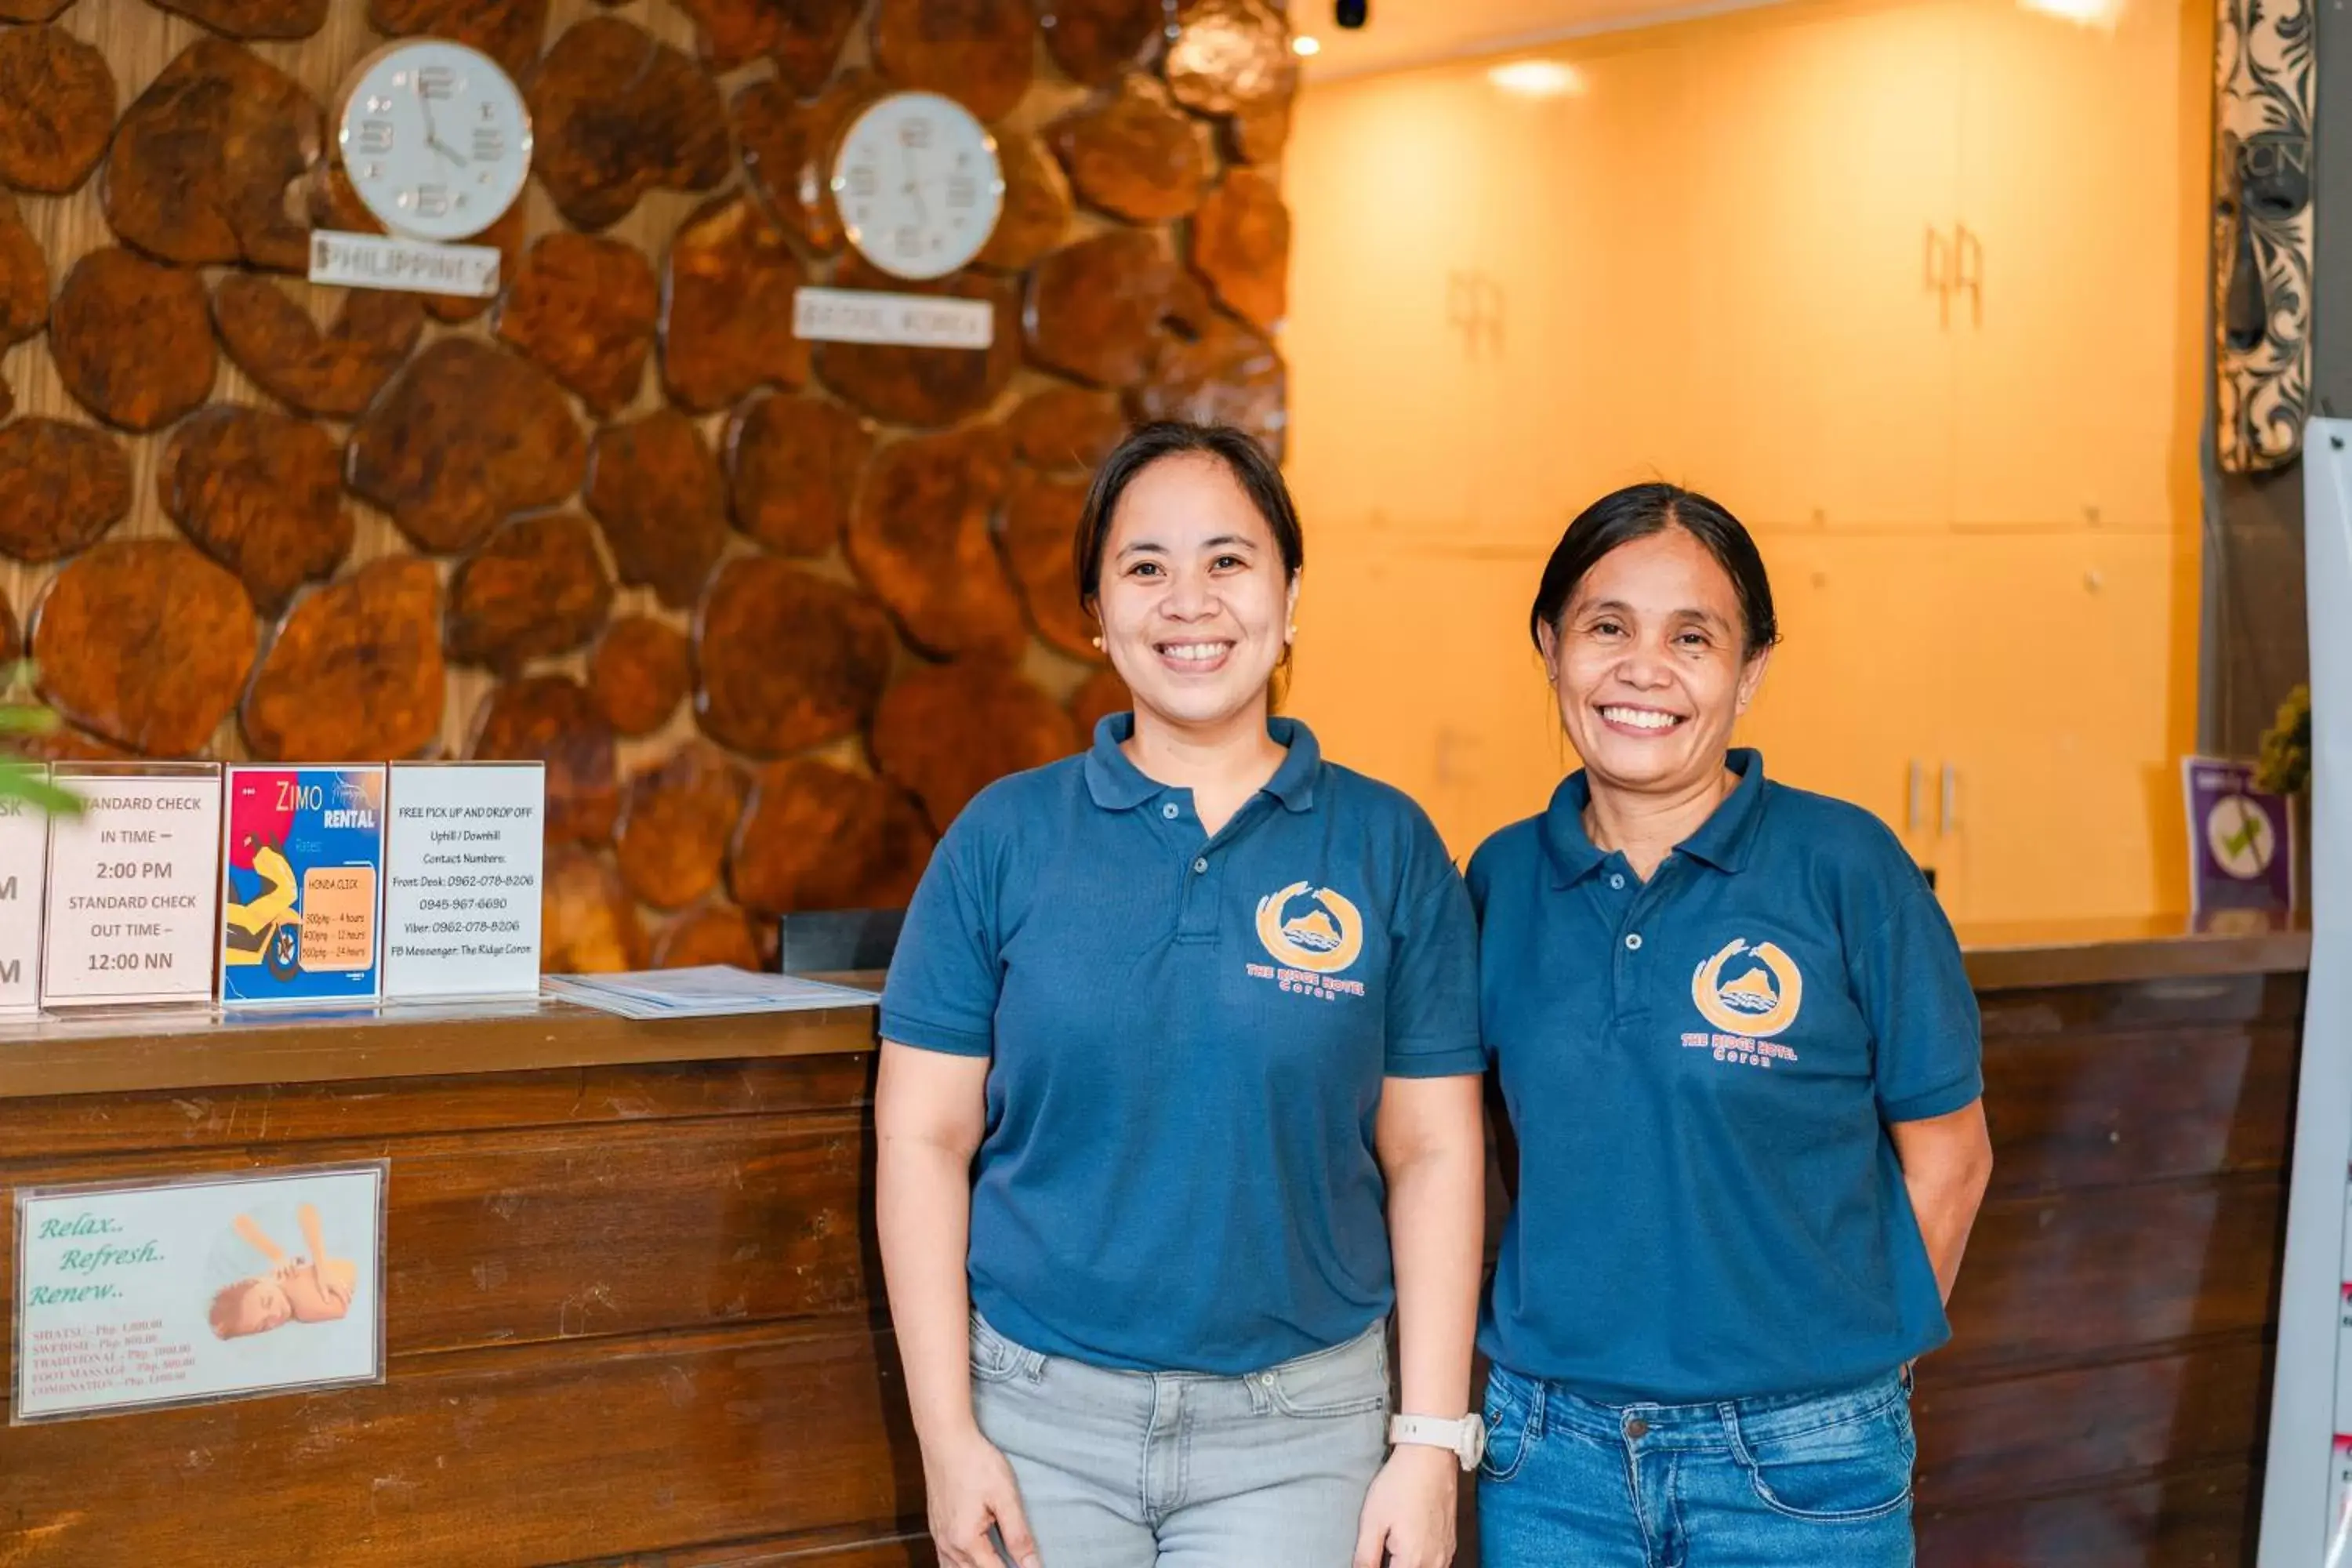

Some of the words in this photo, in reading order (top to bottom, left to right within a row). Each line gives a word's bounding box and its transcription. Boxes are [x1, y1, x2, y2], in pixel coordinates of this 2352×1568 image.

[276, 781, 322, 811] ZIMO
[80, 797, 152, 810] TANDARD
[156, 797, 201, 810] CHECK
[324, 809, 375, 829] RENTAL
[398, 807, 423, 818] FREE
[426, 807, 448, 818] PICK
[449, 807, 463, 818] UP
[463, 807, 485, 818] AND
[486, 807, 513, 818] DROP
[514, 807, 533, 818] OFF
[100, 830, 116, 844] IN
[120, 830, 156, 844] TIME
[430, 830, 456, 846] Uphill
[463, 830, 501, 841] Downhill
[423, 853, 461, 864] Contact
[96, 862, 136, 879] 2:00
[142, 862, 172, 878] PM
[308, 880, 335, 890] HONDA
[337, 879, 358, 890] CLICK
[391, 877, 419, 888] Front
[69, 896, 147, 909] STANDARD
[151, 895, 196, 908] CHECK
[347, 913, 365, 923] hours
[90, 924, 121, 937] OUT
[125, 923, 161, 936] TIME
[347, 930, 365, 940] hours
[347, 946, 365, 956] hours
[391, 946, 404, 956] FB
[461, 945, 477, 955] The
[478, 945, 504, 957] Ridge
[506, 944, 532, 954] Coron
[88, 953, 139, 971] 12:00
[145, 953, 172, 969] NN
[1246, 963, 1274, 979] THE
[1277, 968, 1319, 985] RIDGE
[1322, 976, 1365, 996] HOTEL
[1681, 1033, 1708, 1047] THE
[1711, 1034, 1755, 1052] RIDGE
[1757, 1040, 1798, 1061] HOTEL
[32, 1341, 89, 1354] SWEDISH
[32, 1352, 114, 1369] TRADITIONAL
[31, 1370, 64, 1383] FOOT
[31, 1379, 114, 1396] COMBINATION
